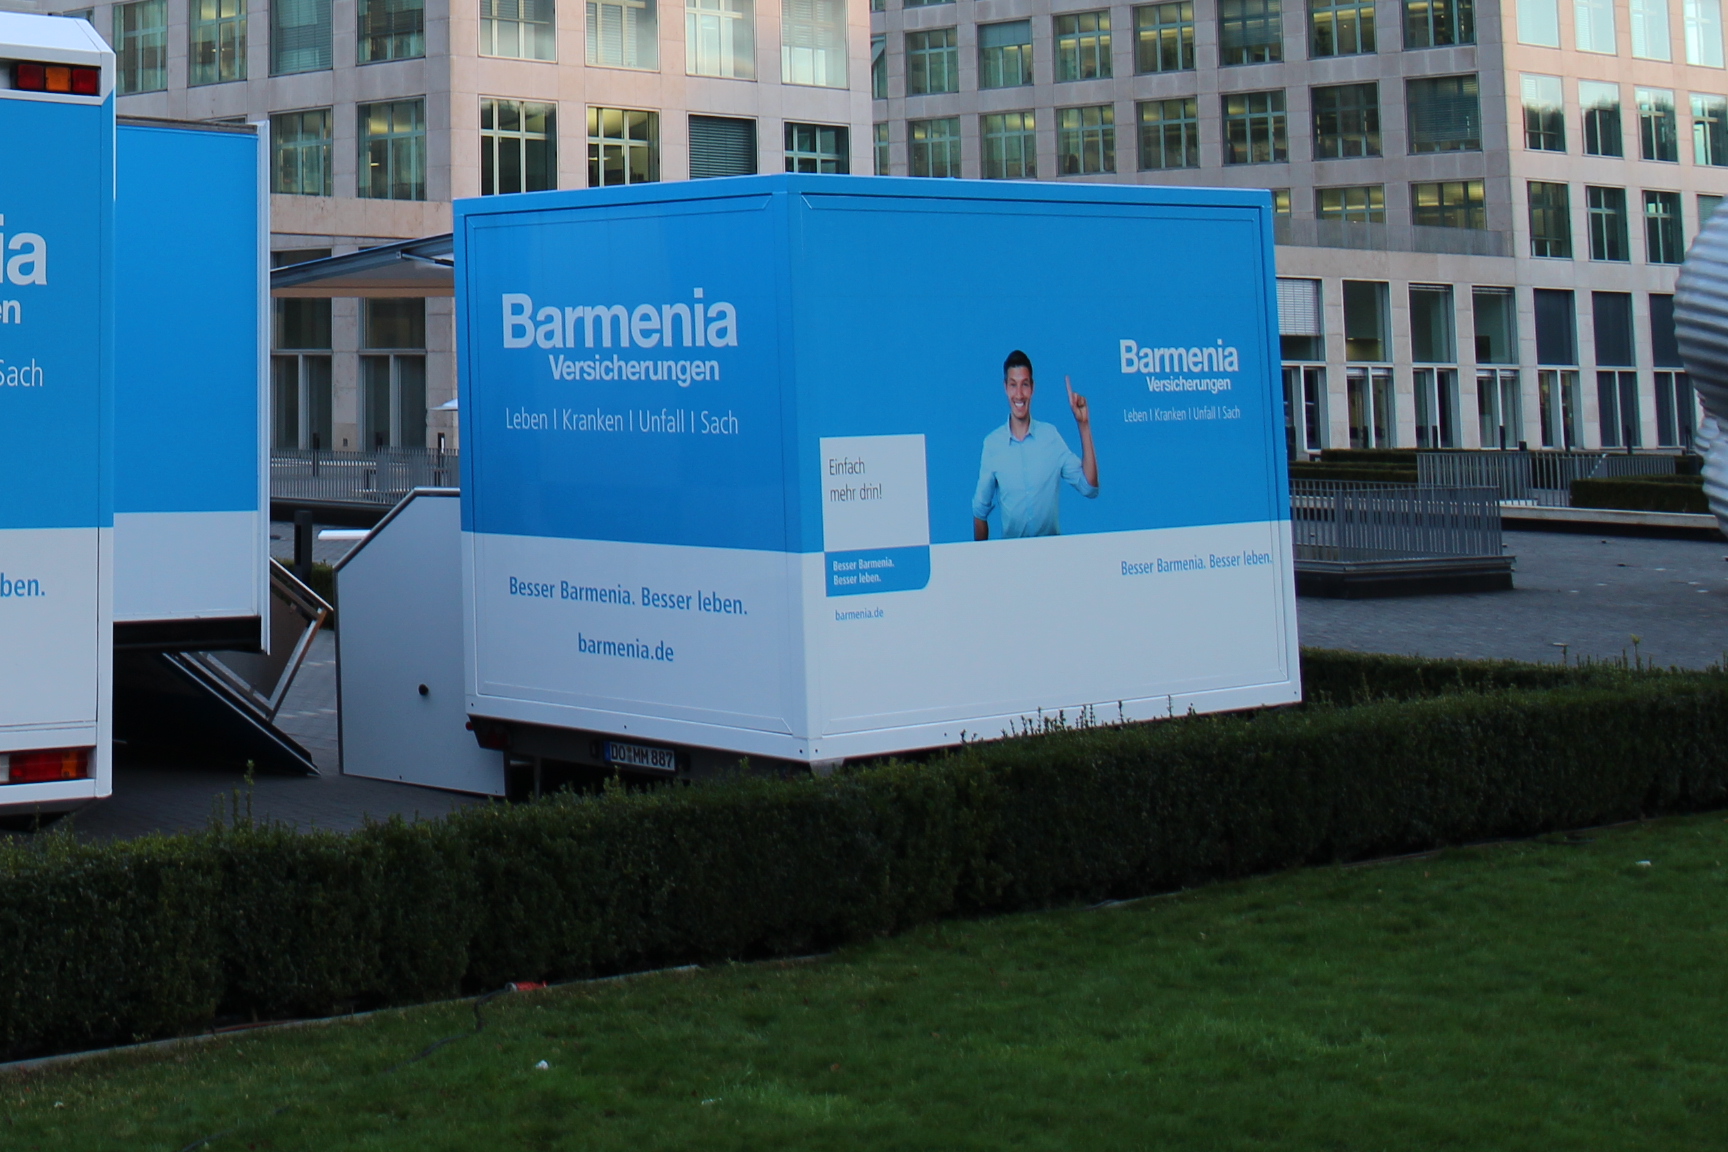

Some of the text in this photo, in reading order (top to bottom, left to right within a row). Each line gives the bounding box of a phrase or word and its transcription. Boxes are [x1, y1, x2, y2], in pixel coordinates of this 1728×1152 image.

[502, 288, 738, 349] Barmenia
[1119, 338, 1240, 375] Barmenia
[548, 354, 720, 388] Versicherungen
[1145, 374, 1232, 395] Versicherungen
[506, 406, 548, 430] Leben
[562, 407, 624, 432] Kranken
[639, 408, 685, 433] Unfall
[700, 409, 739, 435] Sach
[1123, 408, 1148, 423] Leben
[1154, 407, 1187, 422] Kranken
[1193, 405, 1217, 421] Unfall
[1222, 405, 1241, 420] Sach
[829, 456, 866, 476] Einfach
[830, 482, 882, 502] mehr drin!
[832, 556, 895, 572] Besser Barmenia.
[1121, 550, 1274, 576] Besser Barmenia. Besser leben.
[833, 571, 882, 586] Besser leben.
[509, 576, 748, 615] Besser Barmenia. Besser leben.
[835, 607, 884, 622] barmenia.de
[578, 632, 674, 662] barmenia.de
[611, 744, 673, 768] DO MM 887
